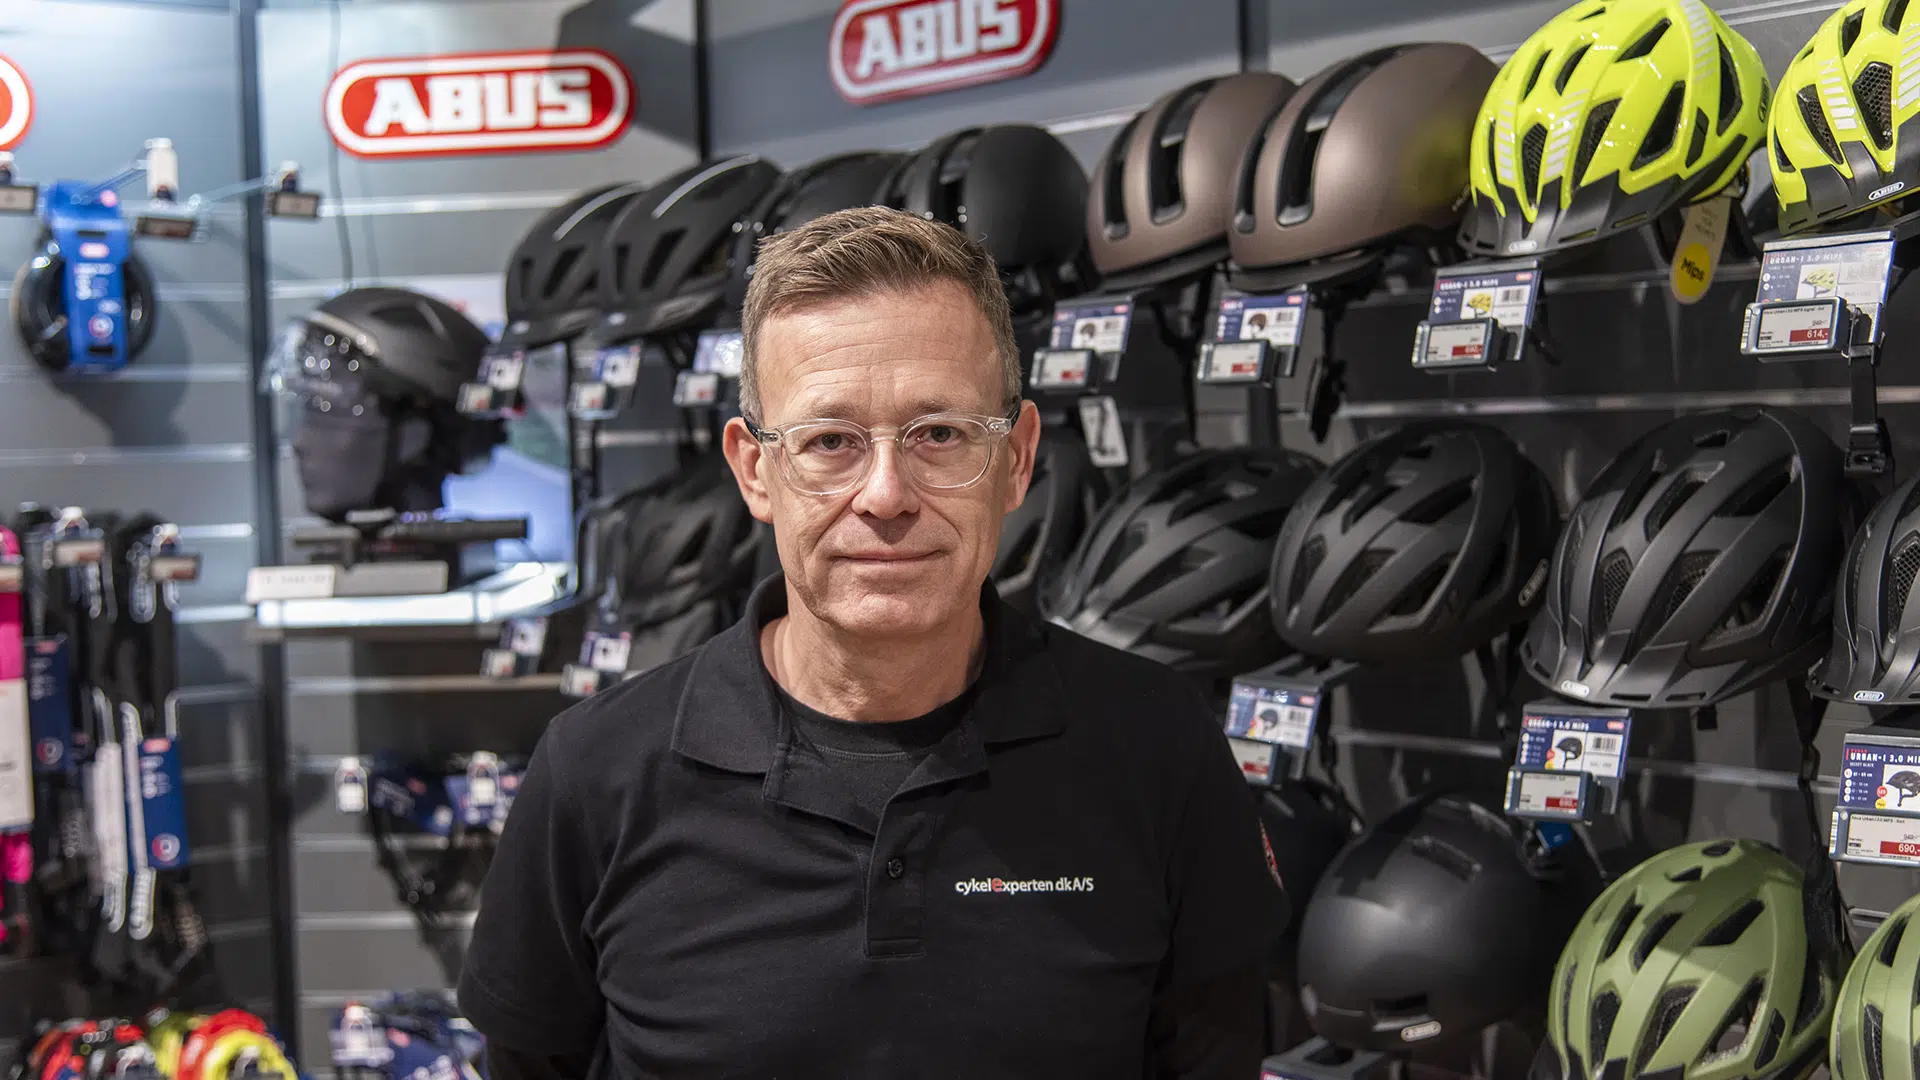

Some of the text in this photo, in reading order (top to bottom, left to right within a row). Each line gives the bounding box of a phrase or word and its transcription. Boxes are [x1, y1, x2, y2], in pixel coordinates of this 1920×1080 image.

[856, 0, 1020, 77] ABUS
[364, 68, 592, 136] ABUS
[1680, 256, 1705, 282] Mips
[1806, 329, 1828, 338] 614,-
[1889, 754, 1904, 763] 3.0
[955, 877, 1054, 895] cykelexperten
